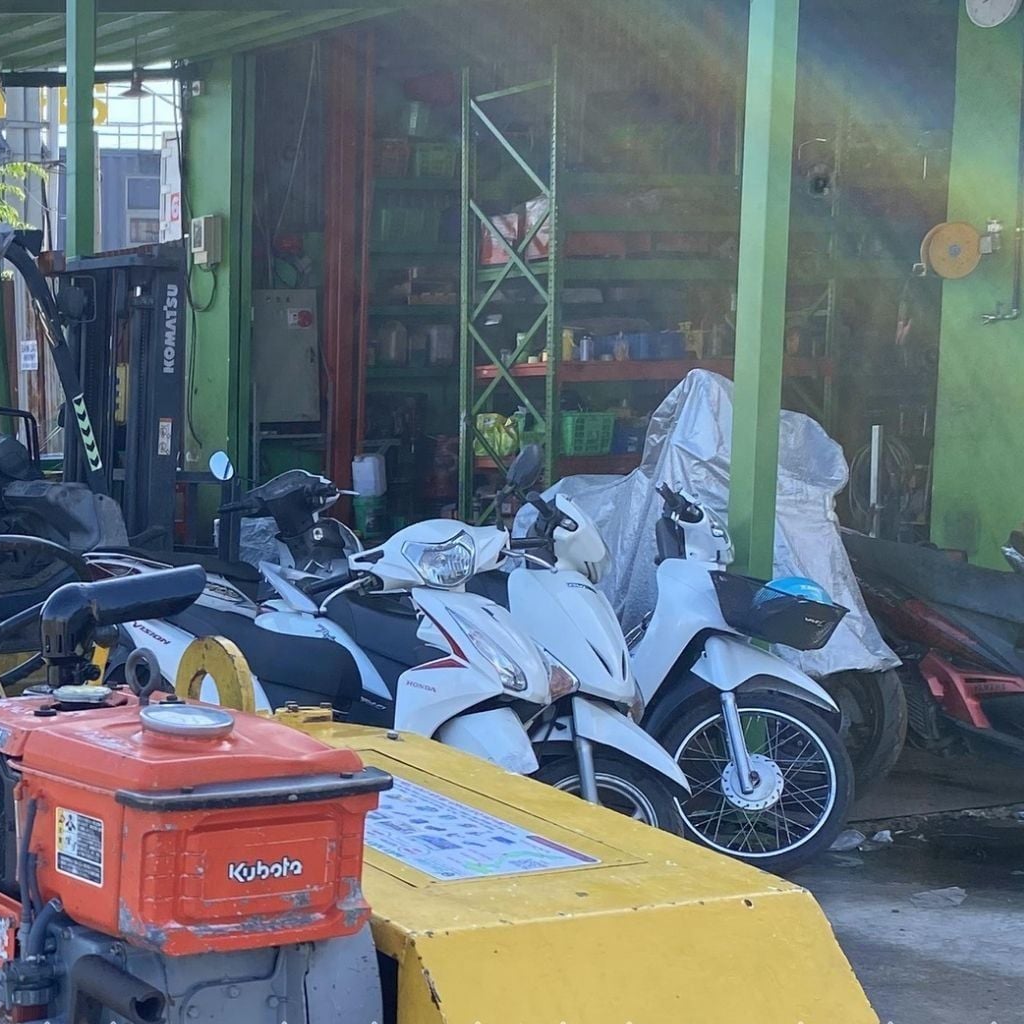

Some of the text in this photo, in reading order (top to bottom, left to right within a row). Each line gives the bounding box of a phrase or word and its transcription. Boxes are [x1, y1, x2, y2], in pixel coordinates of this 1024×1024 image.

[163, 284, 179, 374] KOMATSU
[132, 620, 172, 645] VISION
[406, 680, 437, 693] HONDA
[227, 856, 303, 883] Kubota
